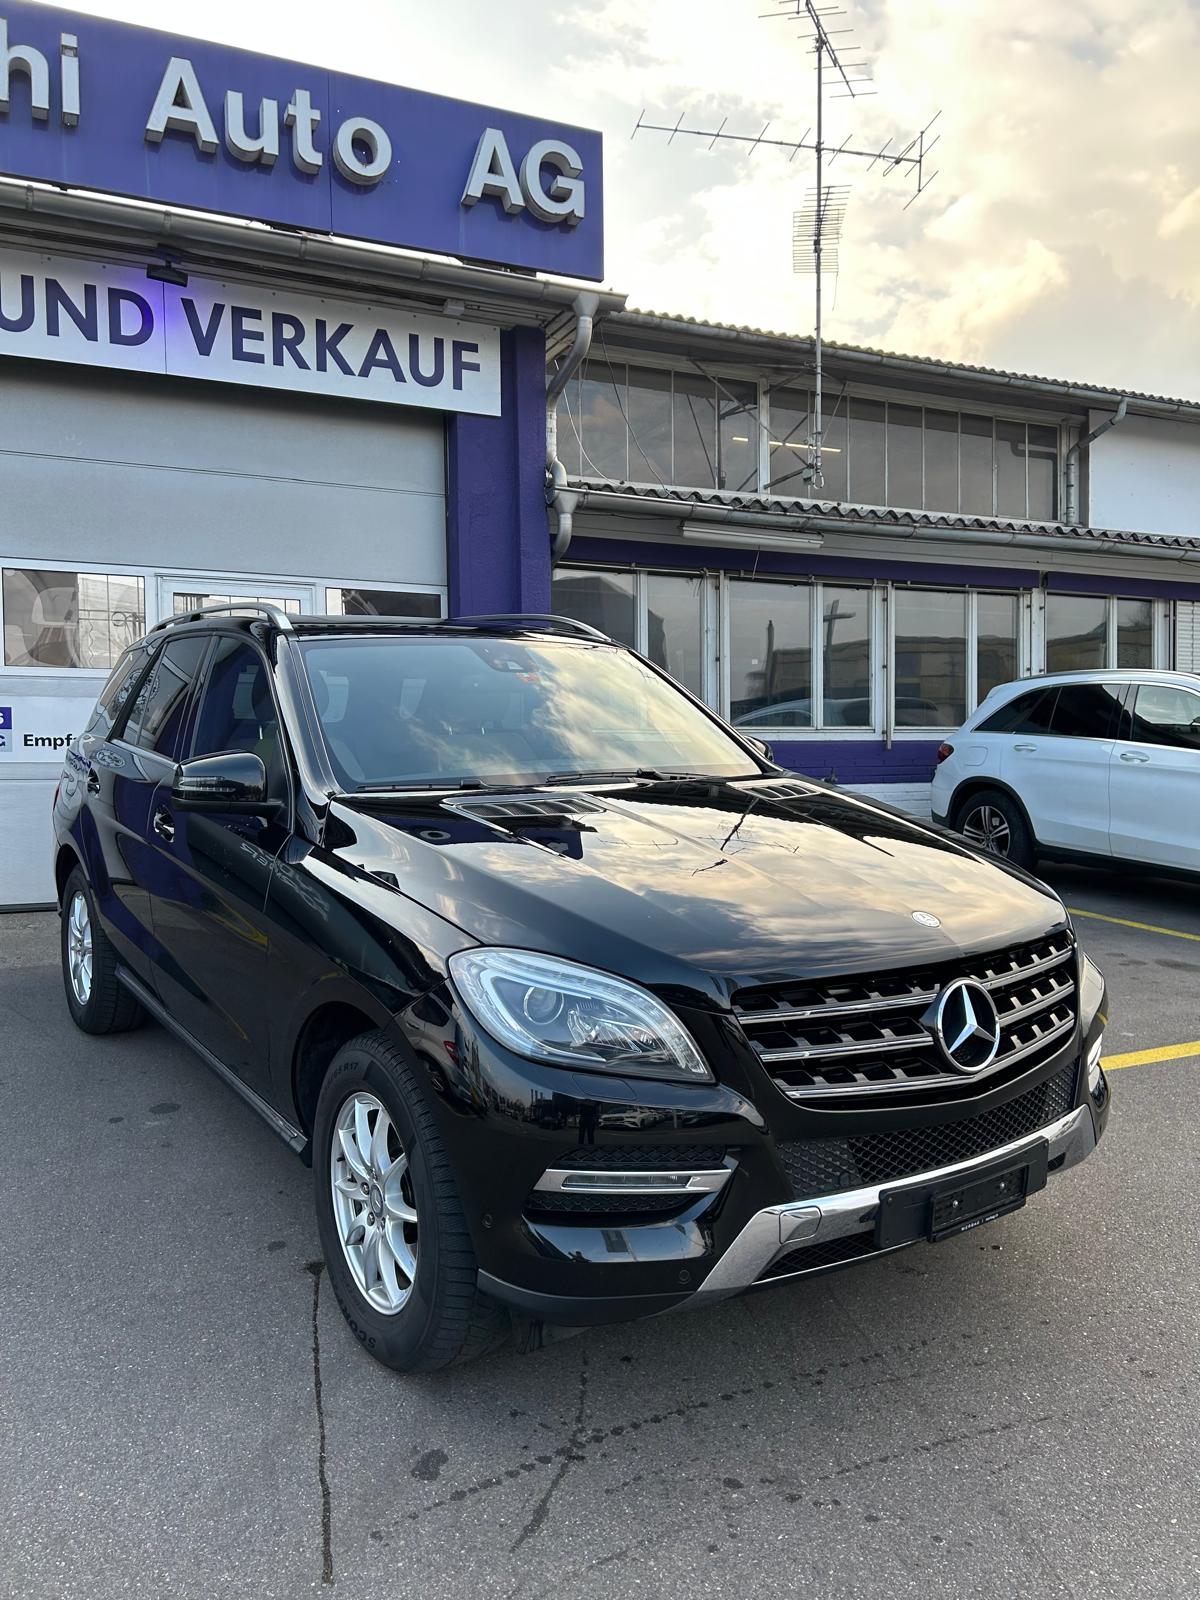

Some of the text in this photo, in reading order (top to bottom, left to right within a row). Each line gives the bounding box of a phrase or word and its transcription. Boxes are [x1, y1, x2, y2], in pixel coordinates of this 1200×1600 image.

[145, 57, 393, 184] Auto
[461, 128, 585, 226] AG
[0, 275, 481, 391] UND VERKAUF
[24, 733, 77, 750] Empf
